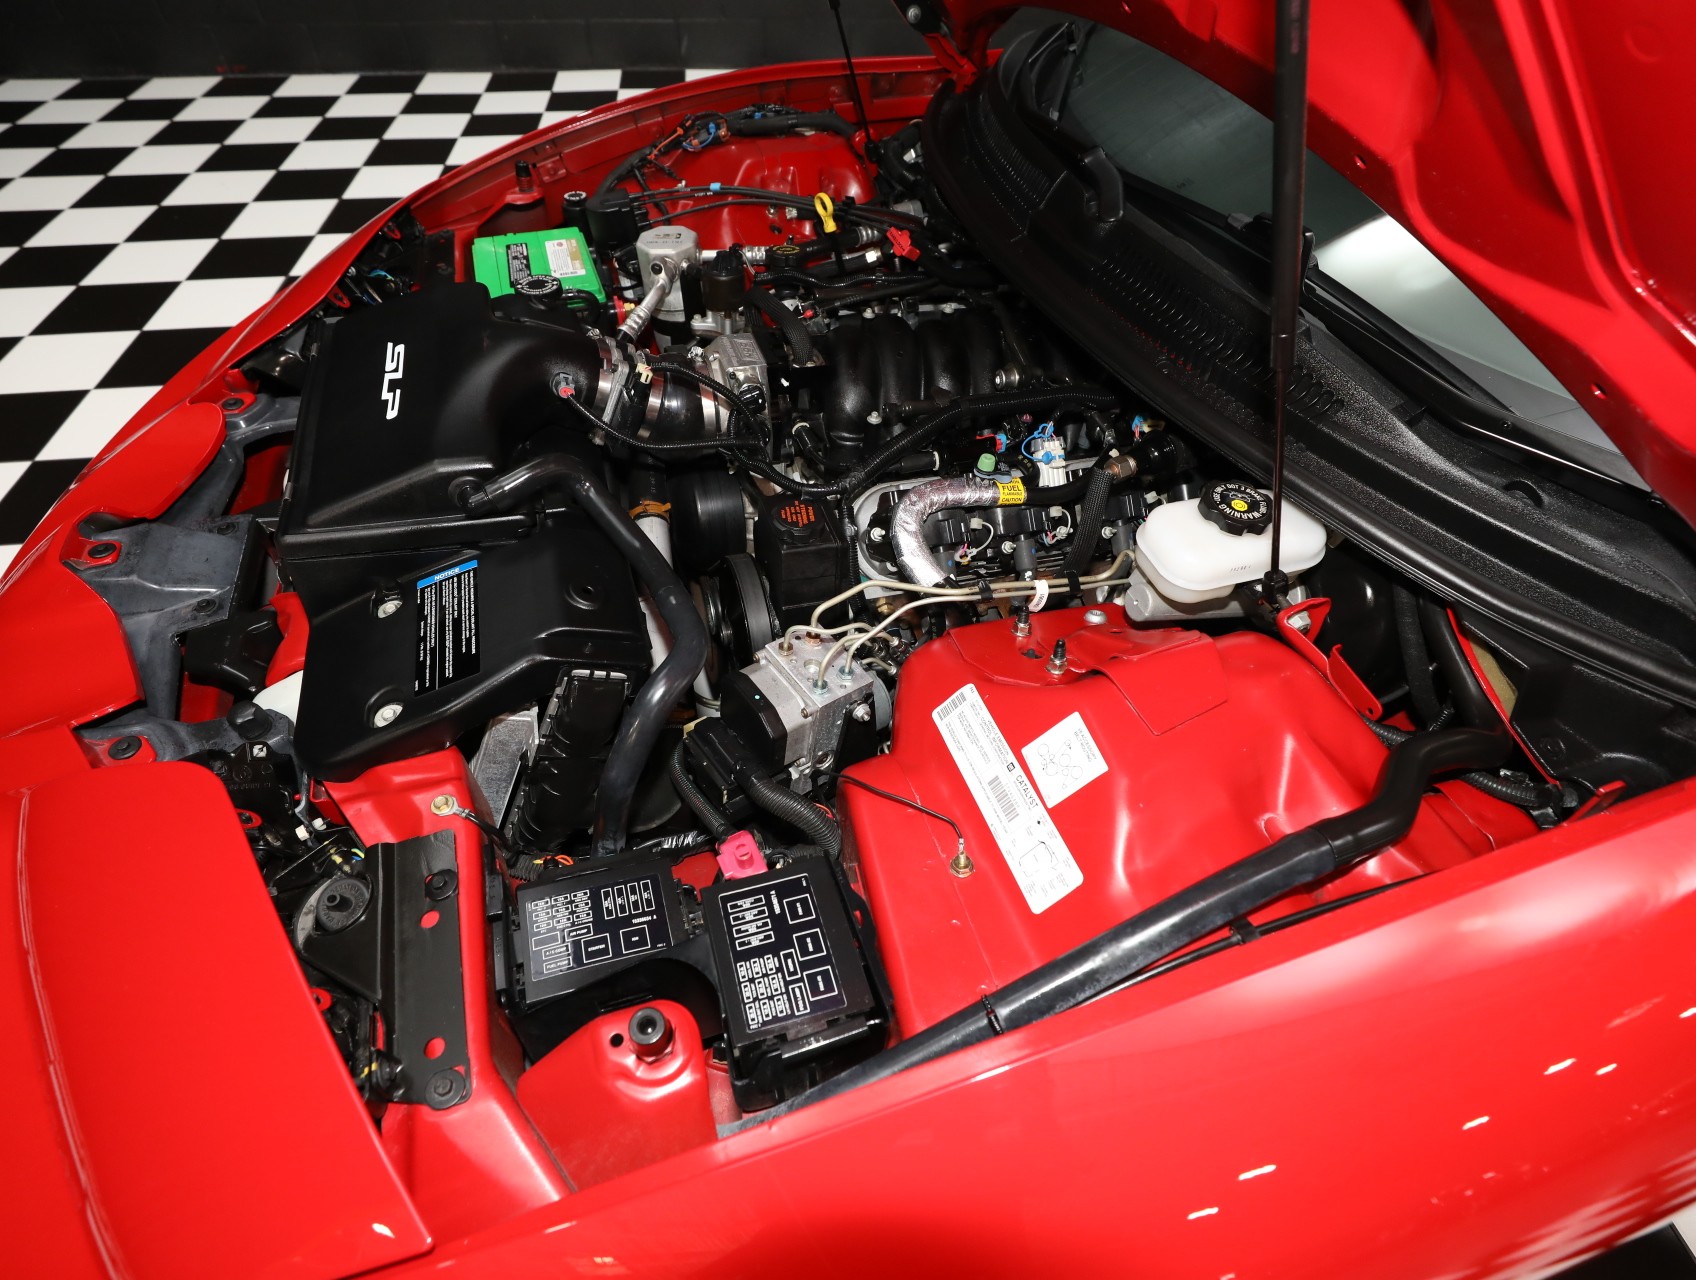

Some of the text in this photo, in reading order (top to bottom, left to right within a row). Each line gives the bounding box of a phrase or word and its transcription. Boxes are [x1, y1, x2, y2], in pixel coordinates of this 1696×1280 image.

[381, 342, 404, 420] SLP
[1219, 504, 1262, 519] WARNING
[435, 568, 459, 580] NOTICE
[1016, 774, 1038, 809] CATALYST
